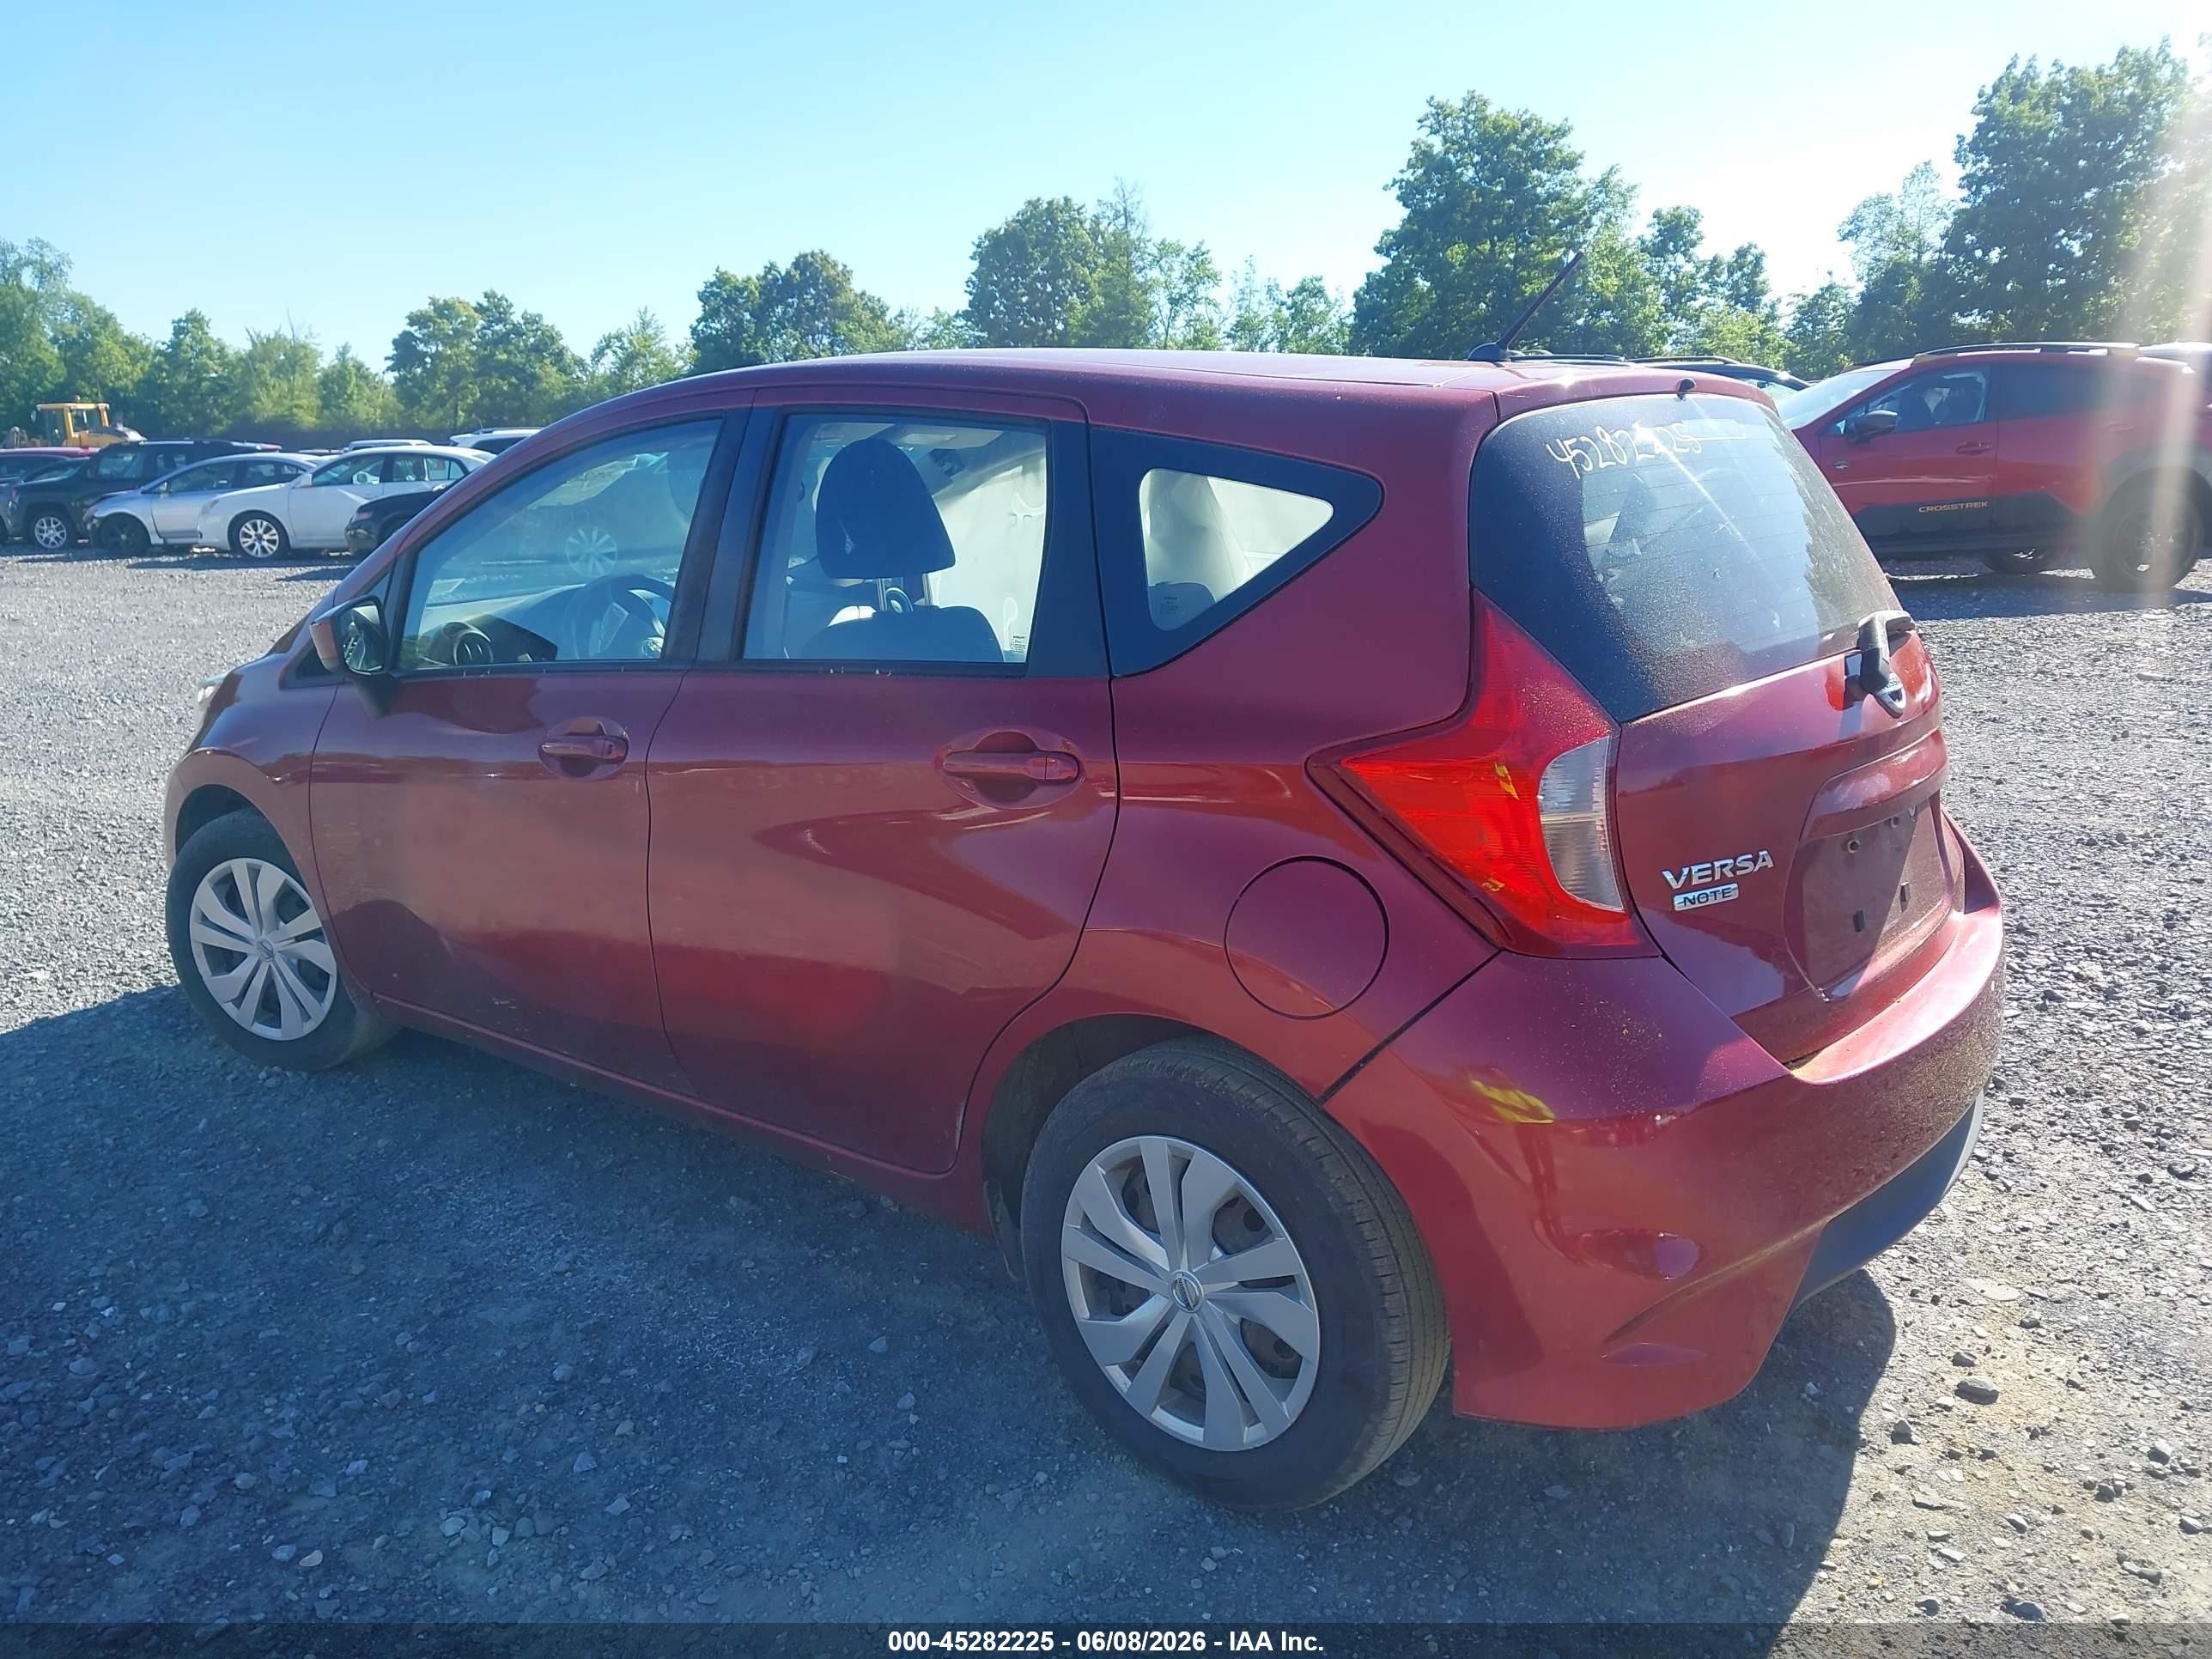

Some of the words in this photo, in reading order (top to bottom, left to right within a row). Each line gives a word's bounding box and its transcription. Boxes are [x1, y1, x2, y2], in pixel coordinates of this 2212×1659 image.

[1917, 501, 1989, 514] CROSSTREK
[1661, 849, 1775, 890] VERSA
[1682, 887, 1733, 908] NOTE
